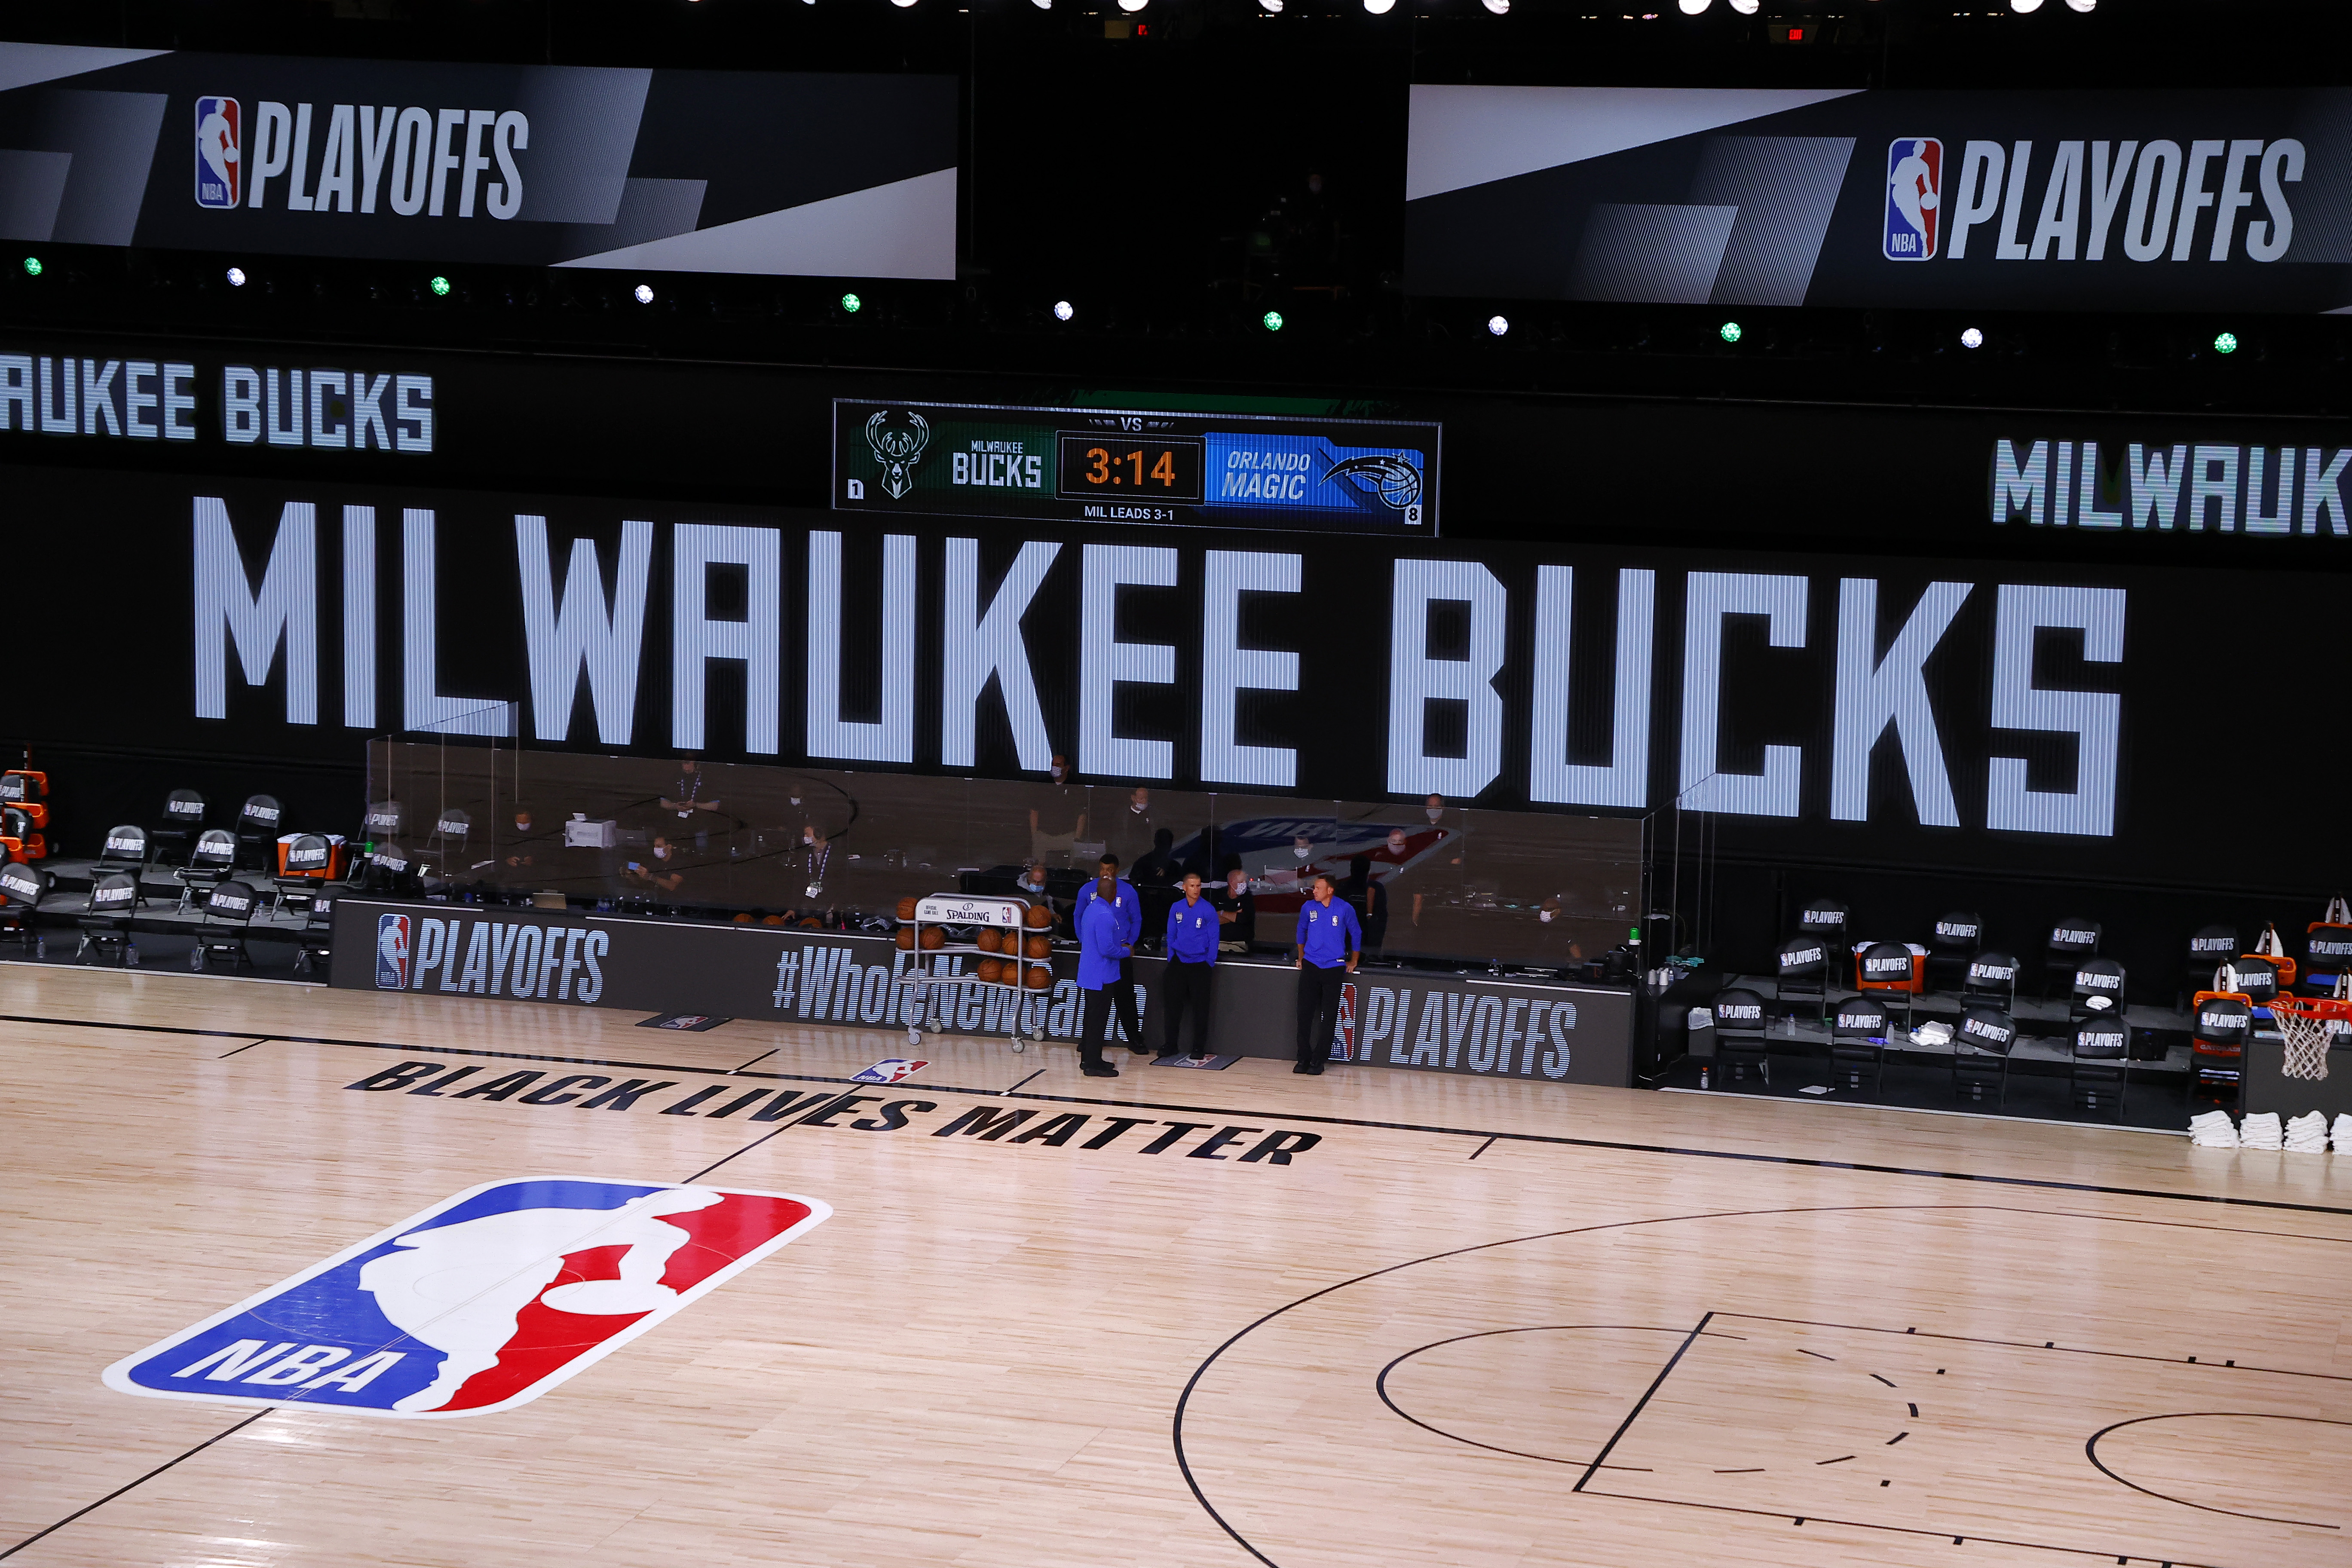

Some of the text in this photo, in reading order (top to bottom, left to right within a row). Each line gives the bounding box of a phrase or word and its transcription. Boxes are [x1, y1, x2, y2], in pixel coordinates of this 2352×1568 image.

[248, 101, 529, 220] PLAYOFFS
[202, 183, 223, 200] NBA
[1947, 138, 2306, 262] PLAYOFFS
[1892, 233, 1916, 252] NBA
[0, 355, 433, 452] AUKEE BUCKS
[1121, 417, 1142, 431] VS
[971, 440, 1023, 454] MILWAUKEE
[1086, 448, 1175, 486] 3:14
[1228, 451, 1311, 471] ORLANDO
[953, 452, 1041, 488] BUCKS
[851, 482, 858, 496] 1
[1222, 472, 1306, 499] MAGIC
[1993, 439, 2352, 535] MILWAUK
[1084, 505, 1173, 521] MIL LEADS 3-1
[1408, 507, 1418, 521] 8
[193, 496, 2128, 837] MILWAUKEE BUCKS
[175, 801, 205, 814] PLAYOFFS
[250, 805, 279, 821] PLAYOFFS
[443, 821, 469, 834] PLAYOFFS
[115, 837, 144, 851] PLAYOFFS
[204, 841, 235, 855] PLAYOFFS
[296, 848, 326, 862] PLAYOFFS
[6, 876, 40, 896] PLAYOFFS
[102, 887, 134, 900] PLAYOFFS
[218, 894, 249, 910] PLAYOFFS
[946, 909, 989, 922] SPALDING
[1810, 911, 1844, 924] PLAYOFFS
[1942, 923, 1977, 937] PLAYOFFS
[2060, 929, 2096, 944] PLAYOFFS
[2199, 937, 2234, 951] PLAYOFFS
[412, 918, 609, 1003] PLAYOFFS
[1787, 947, 1822, 965] PLAYOFFS
[1872, 957, 1907, 972] PLAYOFFS
[1977, 965, 2013, 980] PLAYOFFS
[2236, 973, 2272, 986] PLAYOFFS
[2083, 973, 2120, 989] PLAYOFFS
[1726, 1005, 1761, 1019] PLAYOFFS
[1845, 1014, 1882, 1029] PLAYOFFS
[2208, 1013, 2248, 1028] PLAYOFFS
[1359, 987, 1577, 1079] PLAYOFFS
[1972, 1020, 2009, 1042] PLAYOFFS
[2085, 1033, 2124, 1047] PLAYOFFS
[341, 1061, 1322, 1166] BLACK LIVES MATTER
[171, 1338, 407, 1393] NBA
